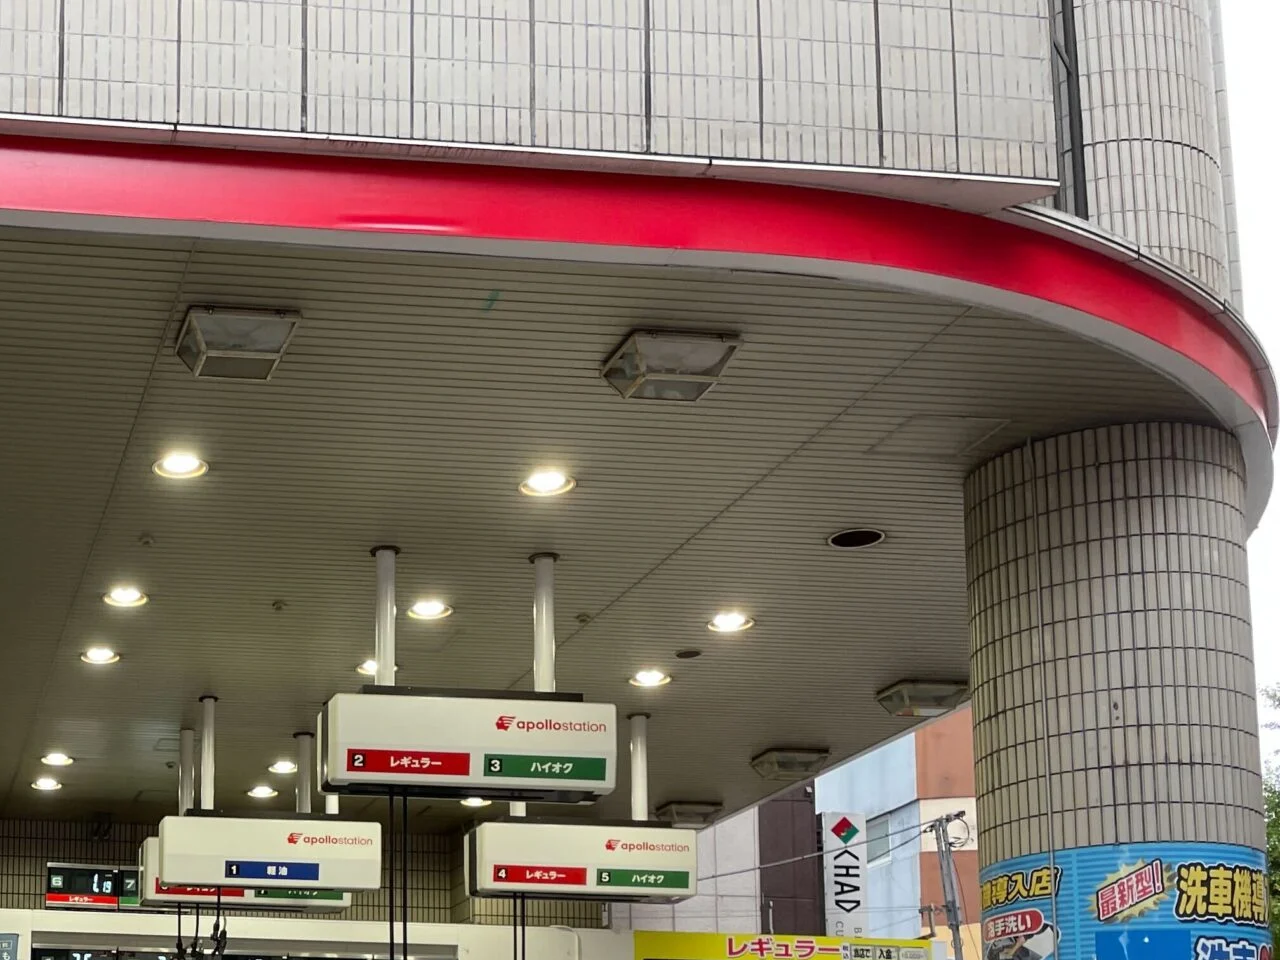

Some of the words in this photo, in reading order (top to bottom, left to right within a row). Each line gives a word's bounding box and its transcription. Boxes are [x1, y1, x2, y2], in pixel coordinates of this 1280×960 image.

[516, 718, 607, 733] apollostation
[353, 755, 364, 767] 2
[389, 756, 442, 769] レギュラー
[490, 759, 500, 772] 3
[530, 762, 574, 774] ハイオク
[303, 834, 373, 846] apollostation
[621, 841, 690, 853] apollostation
[497, 868, 507, 879] 4
[525, 870, 566, 881] レギュラー
[601, 872, 610, 883] 5
[631, 873, 665, 884] ハイオク
[1177, 863, 1269, 926] 洗車機導
[727, 937, 841, 960] レギュラー
